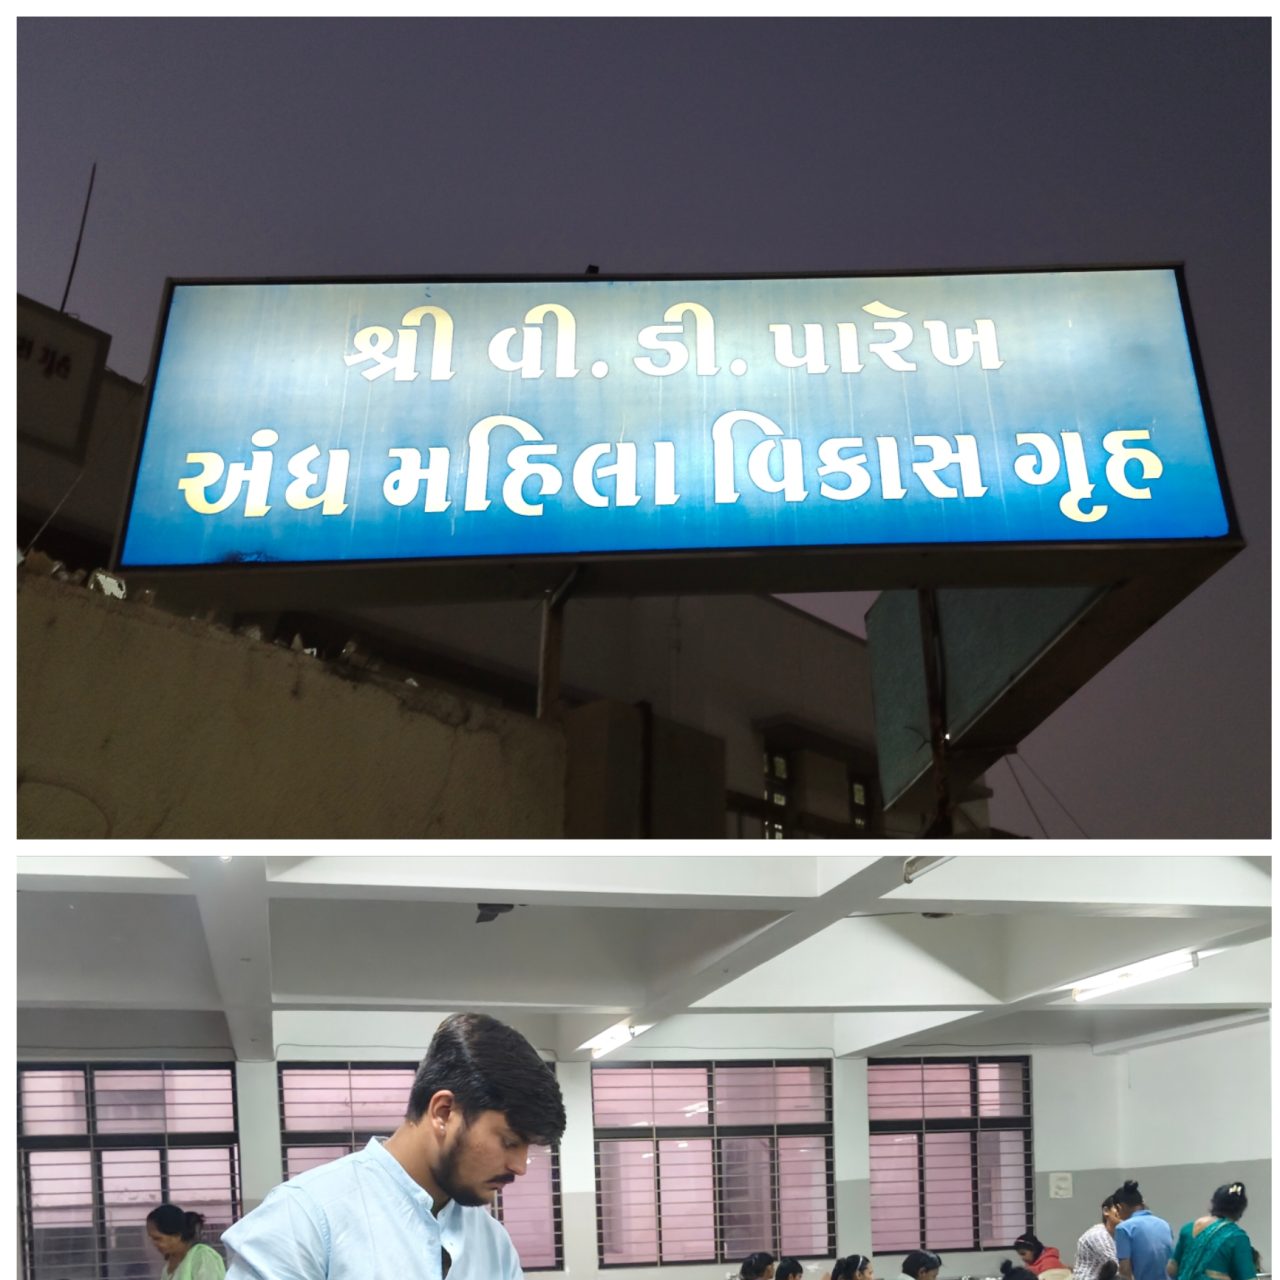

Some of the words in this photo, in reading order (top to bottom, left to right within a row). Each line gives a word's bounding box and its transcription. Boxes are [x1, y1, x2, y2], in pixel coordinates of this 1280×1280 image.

[343, 304, 457, 382] શ્રી
[487, 302, 610, 380] વી.
[633, 301, 748, 377] ડી.
[768, 300, 1006, 375] પારેખ
[177, 428, 350, 518] અંધ
[382, 414, 682, 517] મહિલા
[711, 409, 988, 504] વિકાસ
[1013, 429, 1164, 523] ગૃહ
